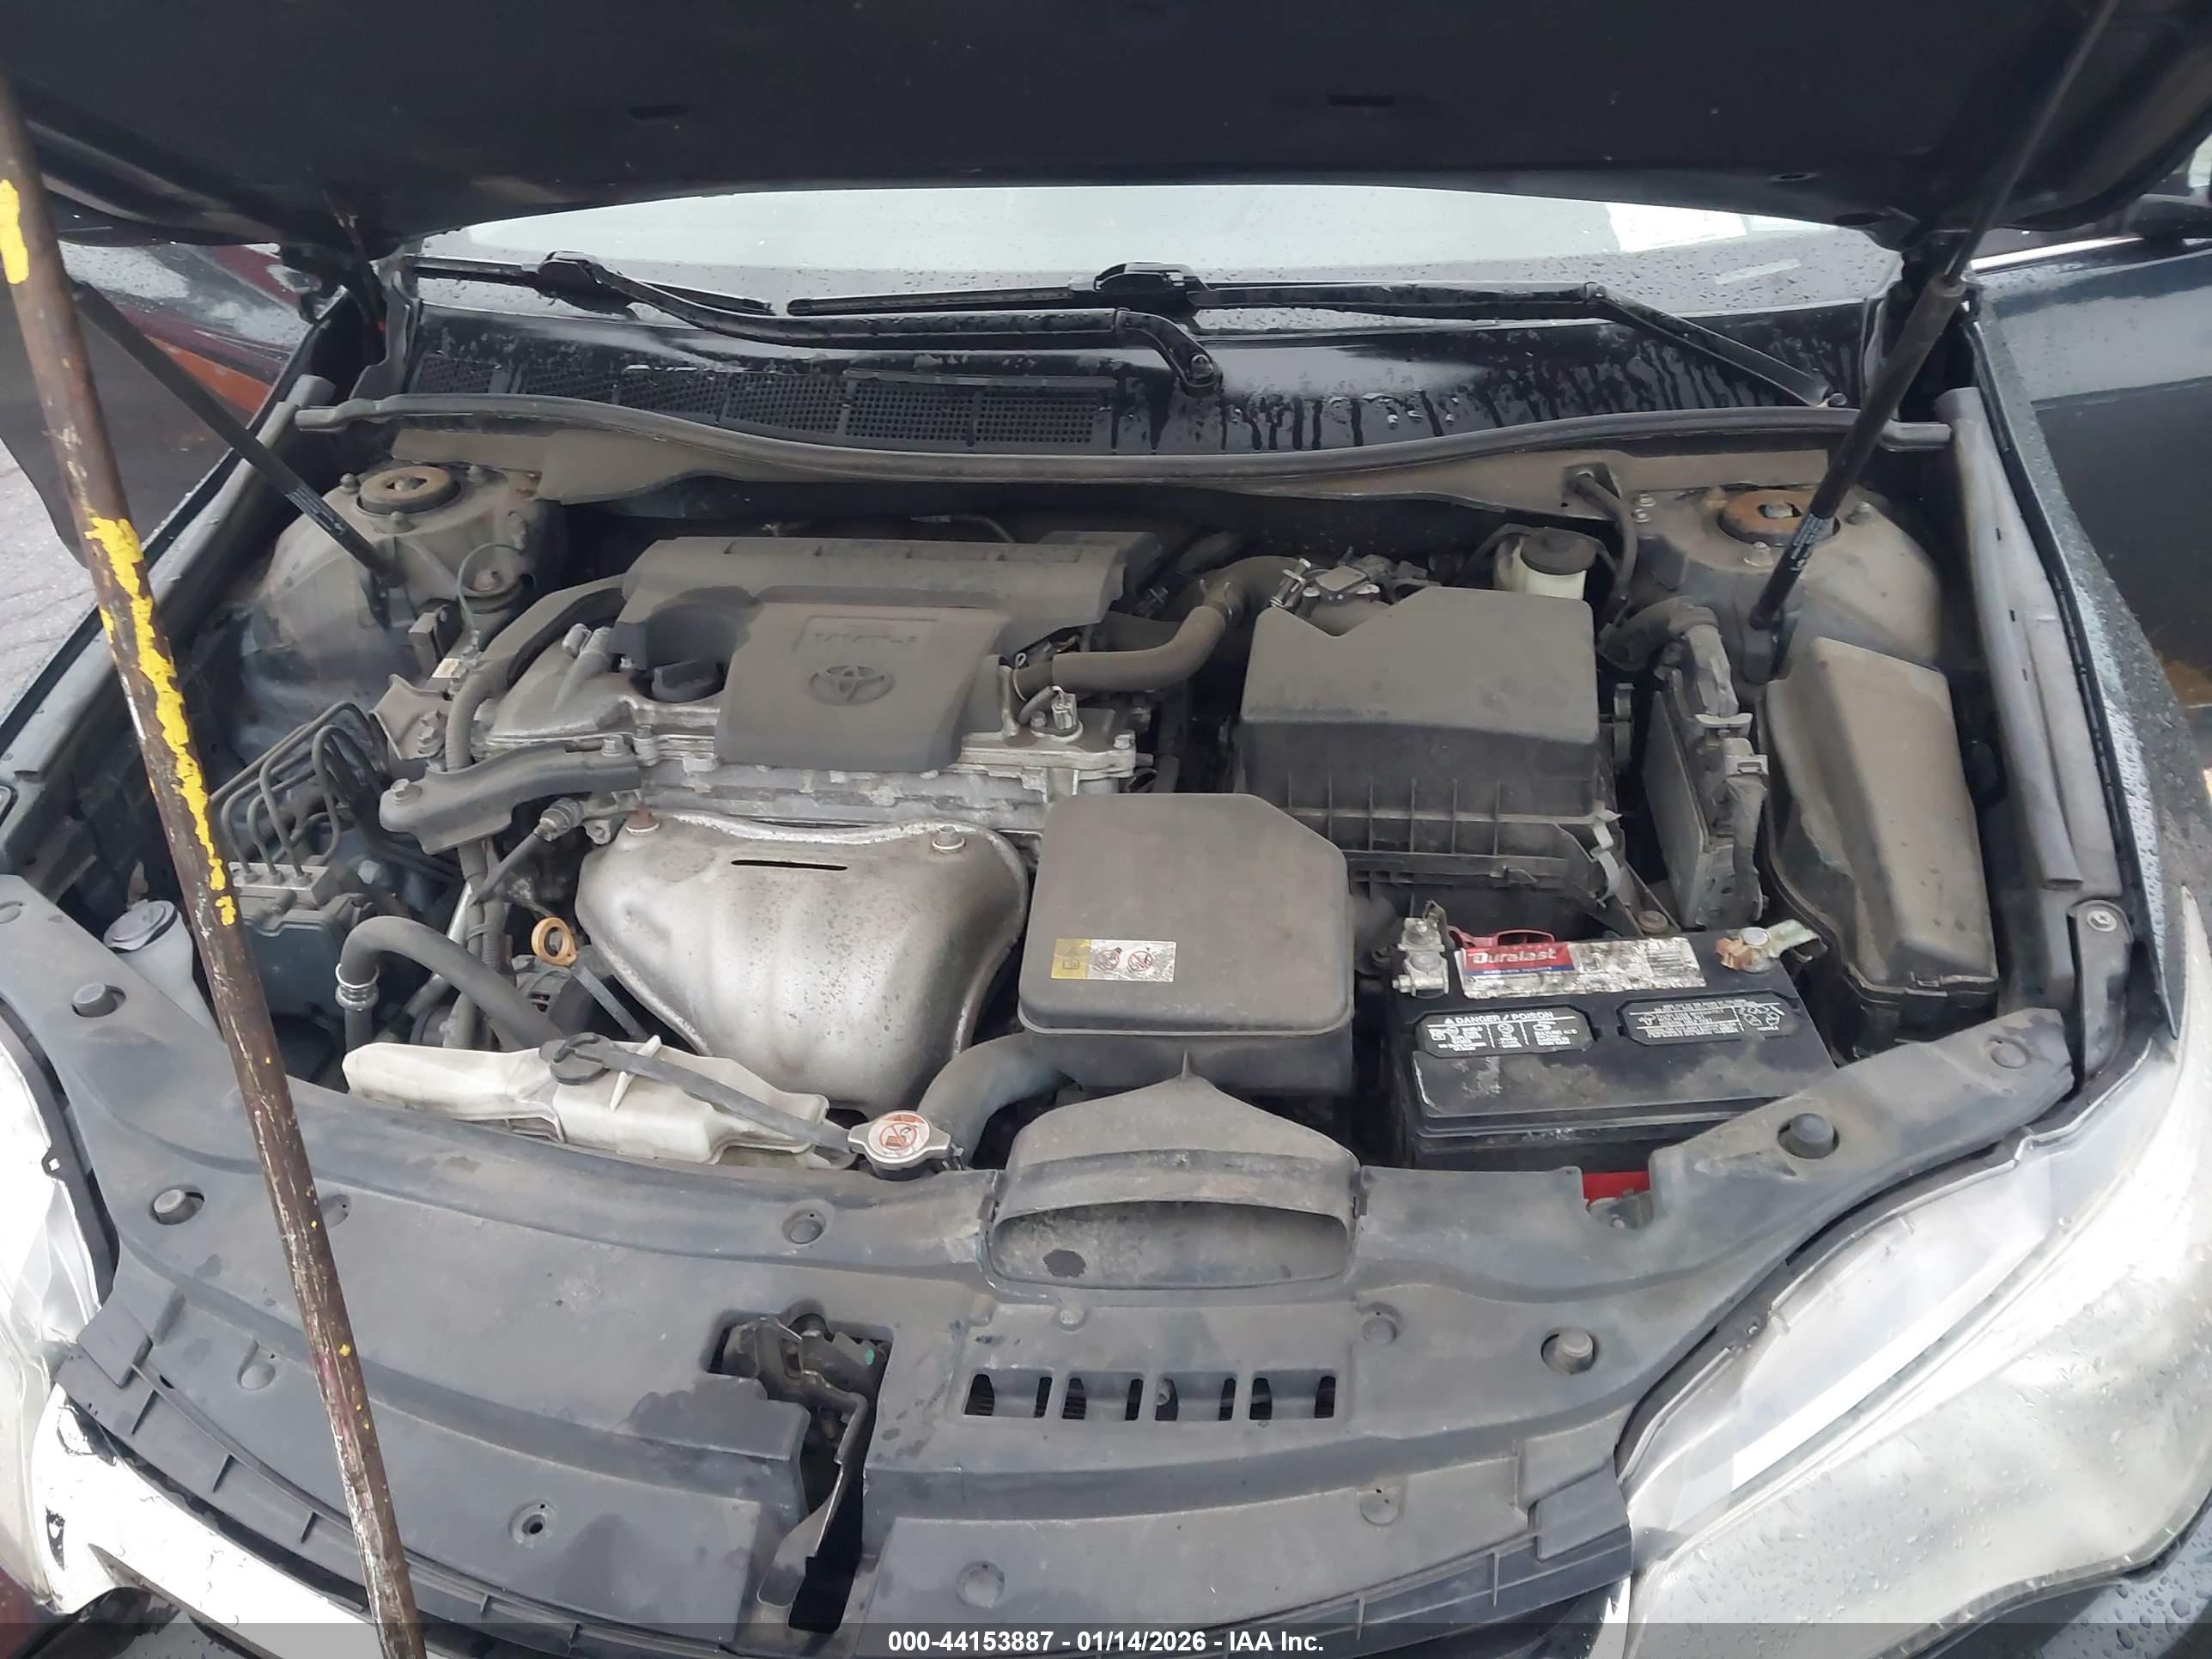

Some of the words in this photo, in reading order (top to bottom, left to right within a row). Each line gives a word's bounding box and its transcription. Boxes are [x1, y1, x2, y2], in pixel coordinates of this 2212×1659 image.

[1468, 947, 1557, 964] Duralast
[1455, 1014, 1501, 1024] DANGER
[1512, 1012, 1554, 1020] POISON
